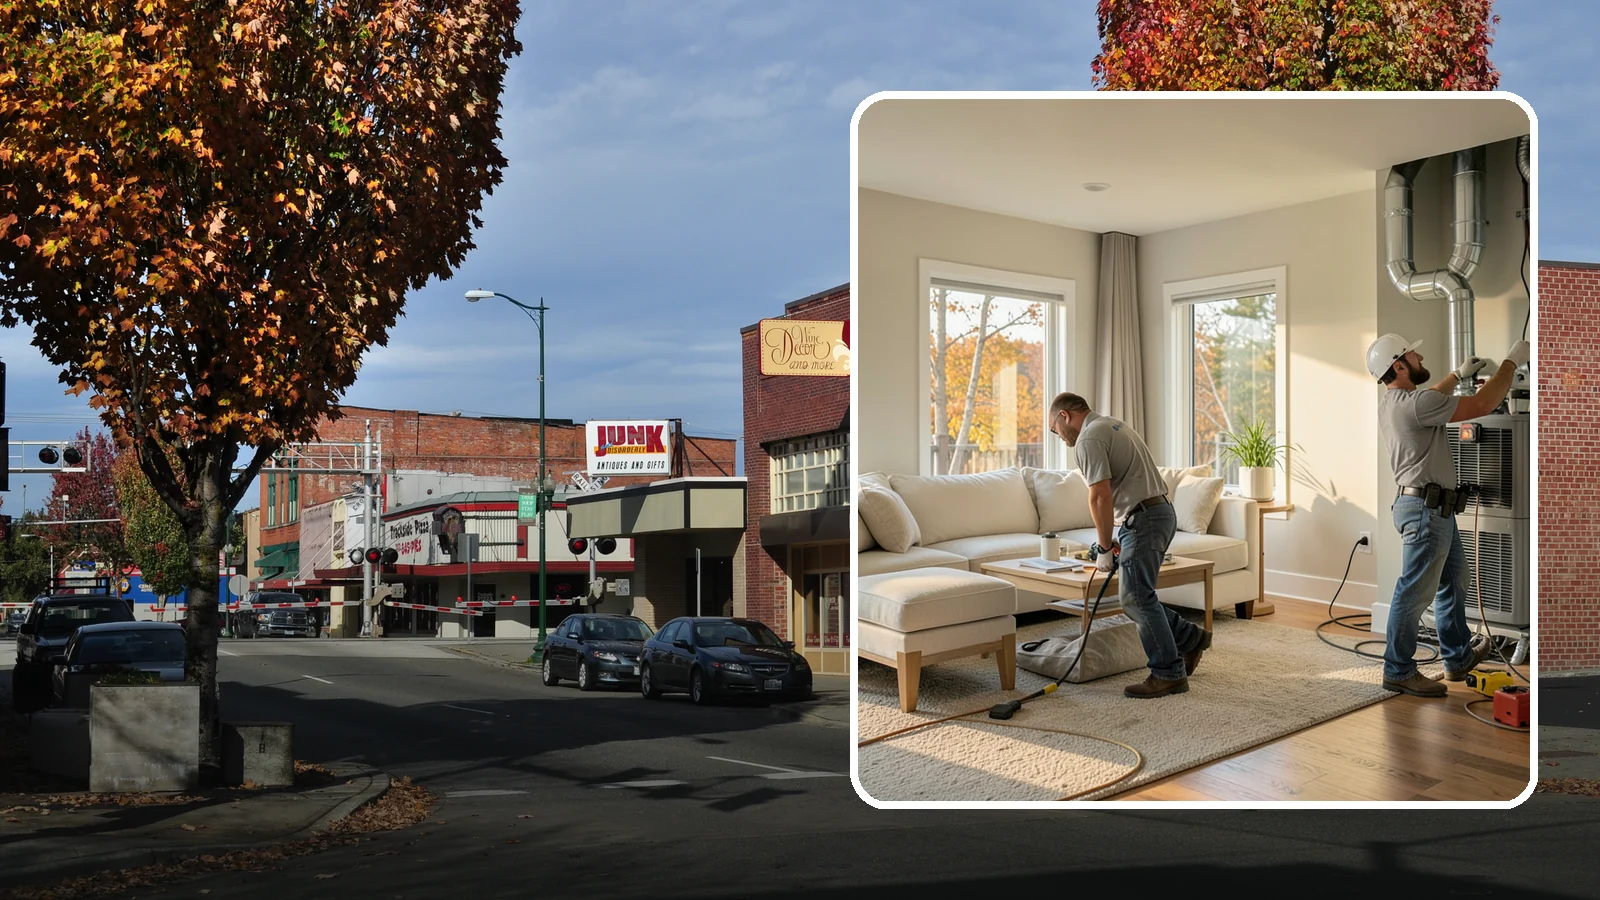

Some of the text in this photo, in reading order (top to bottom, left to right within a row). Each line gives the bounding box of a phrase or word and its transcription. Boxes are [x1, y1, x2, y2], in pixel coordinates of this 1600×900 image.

[765, 328, 831, 365] Decor
[595, 425, 664, 457] JUNK
[607, 446, 646, 454] DISORDERLY
[597, 461, 665, 470] ANTIQUES AND GIFTS
[414, 519, 429, 535] Pizza
